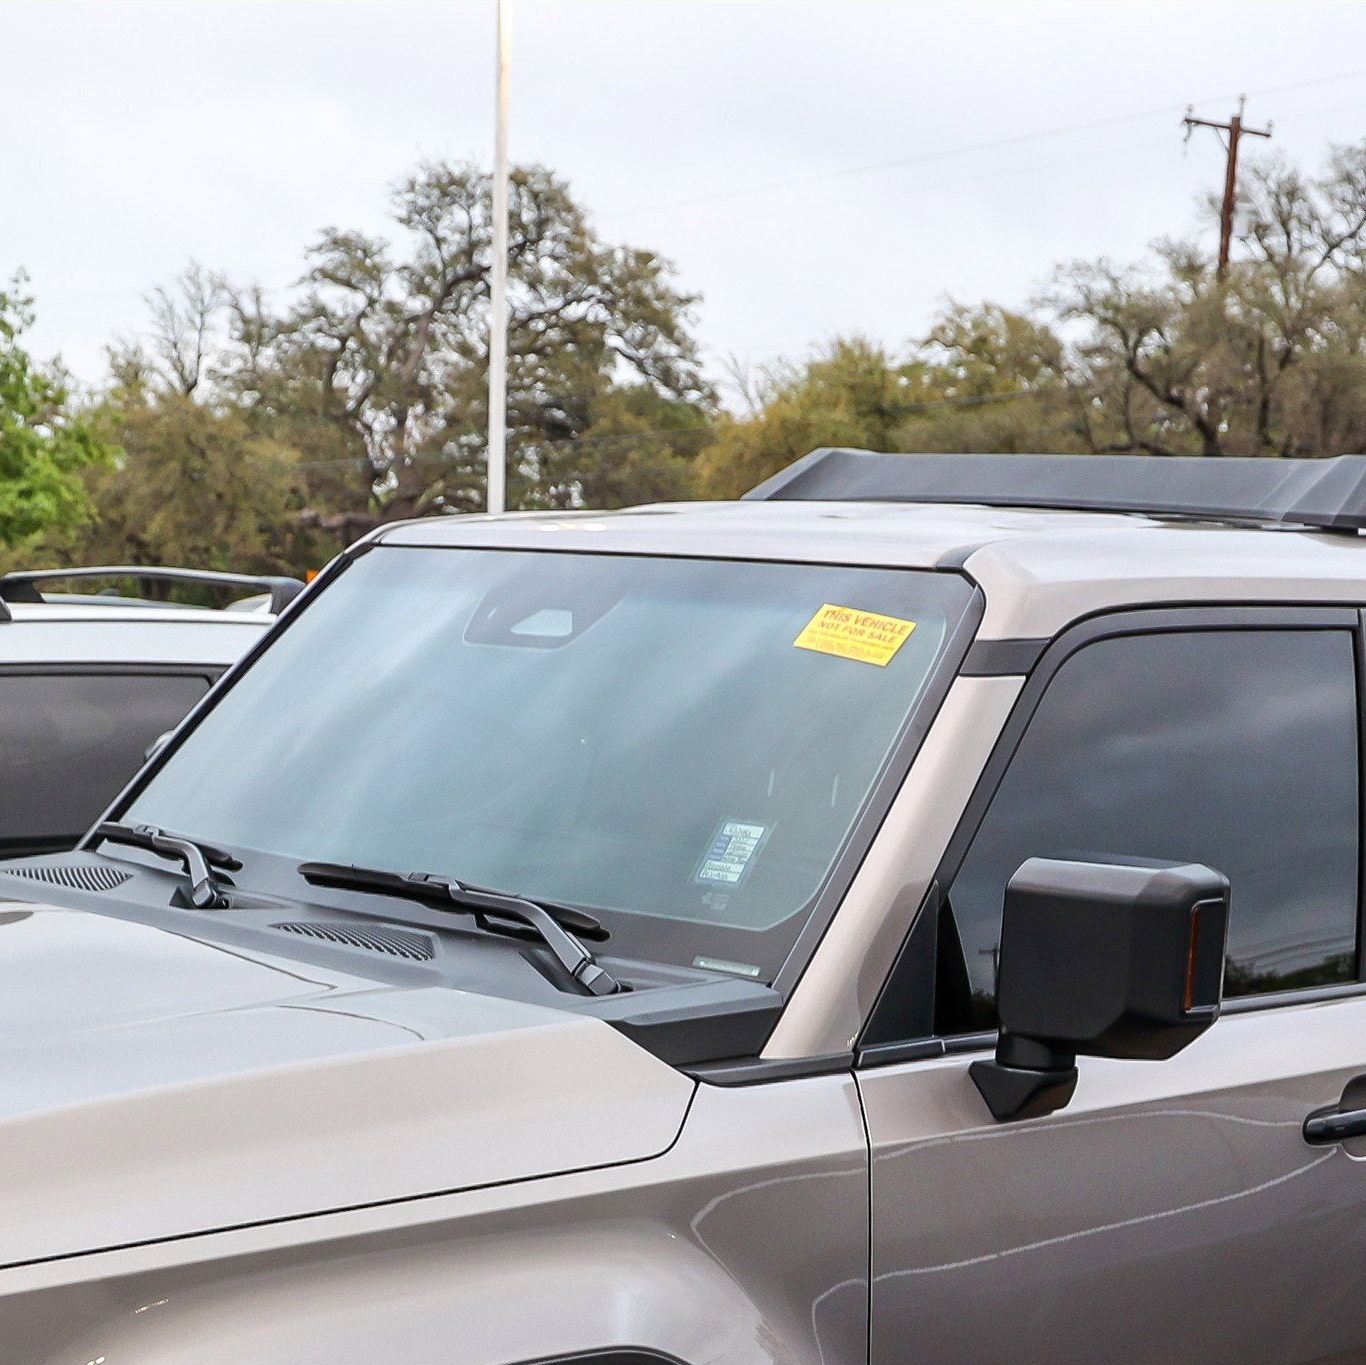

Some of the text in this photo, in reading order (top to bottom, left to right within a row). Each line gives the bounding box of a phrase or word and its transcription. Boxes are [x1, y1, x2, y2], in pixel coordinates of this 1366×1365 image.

[818, 620, 841, 632] NOT
[842, 624, 866, 636] FOR
[867, 630, 897, 643] SALE
[824, 610, 909, 635] THIS VEHICLE
